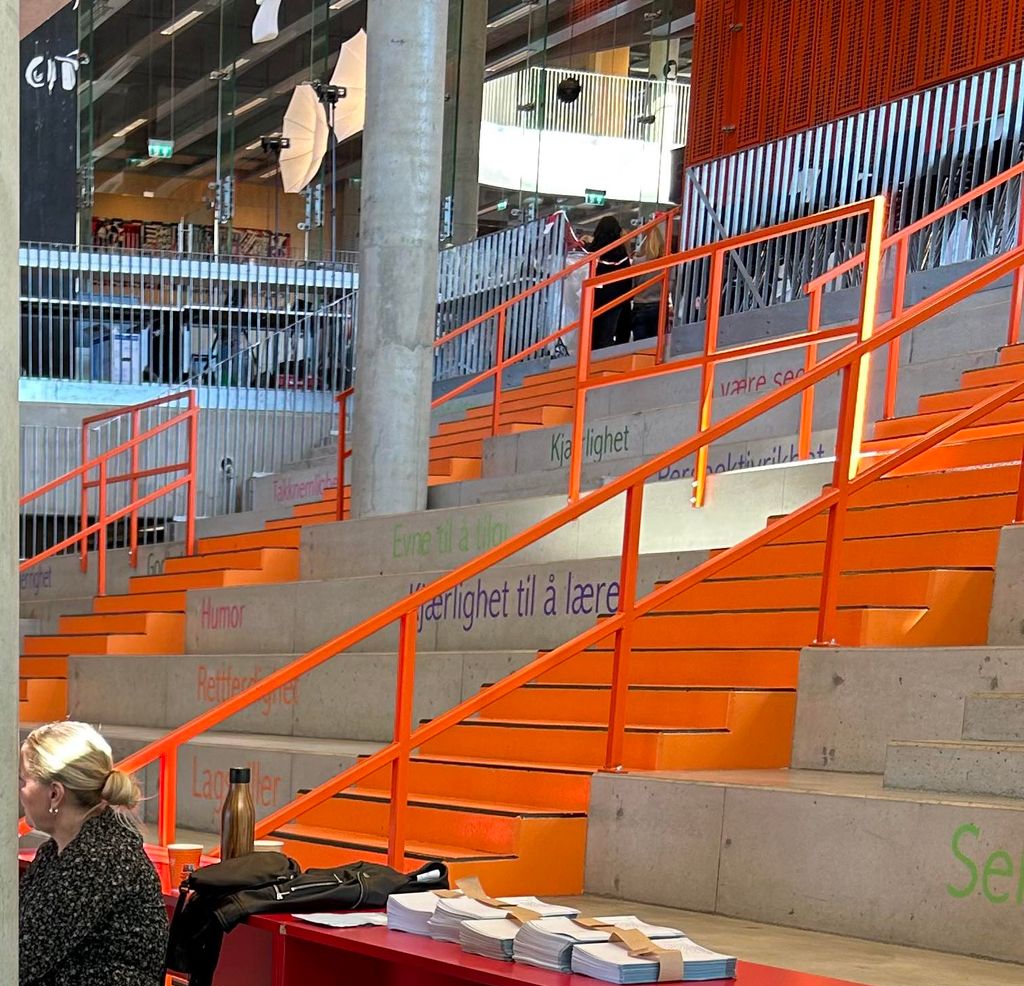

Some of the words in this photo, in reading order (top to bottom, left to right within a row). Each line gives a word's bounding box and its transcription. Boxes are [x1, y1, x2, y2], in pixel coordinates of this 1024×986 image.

[392, 522, 432, 559] Evne
[436, 517, 453, 554] til
[459, 520, 469, 553] å
[201, 598, 246, 629] Humor
[517, 575, 536, 616] til
[543, 574, 557, 615] å
[565, 572, 620, 614] lære
